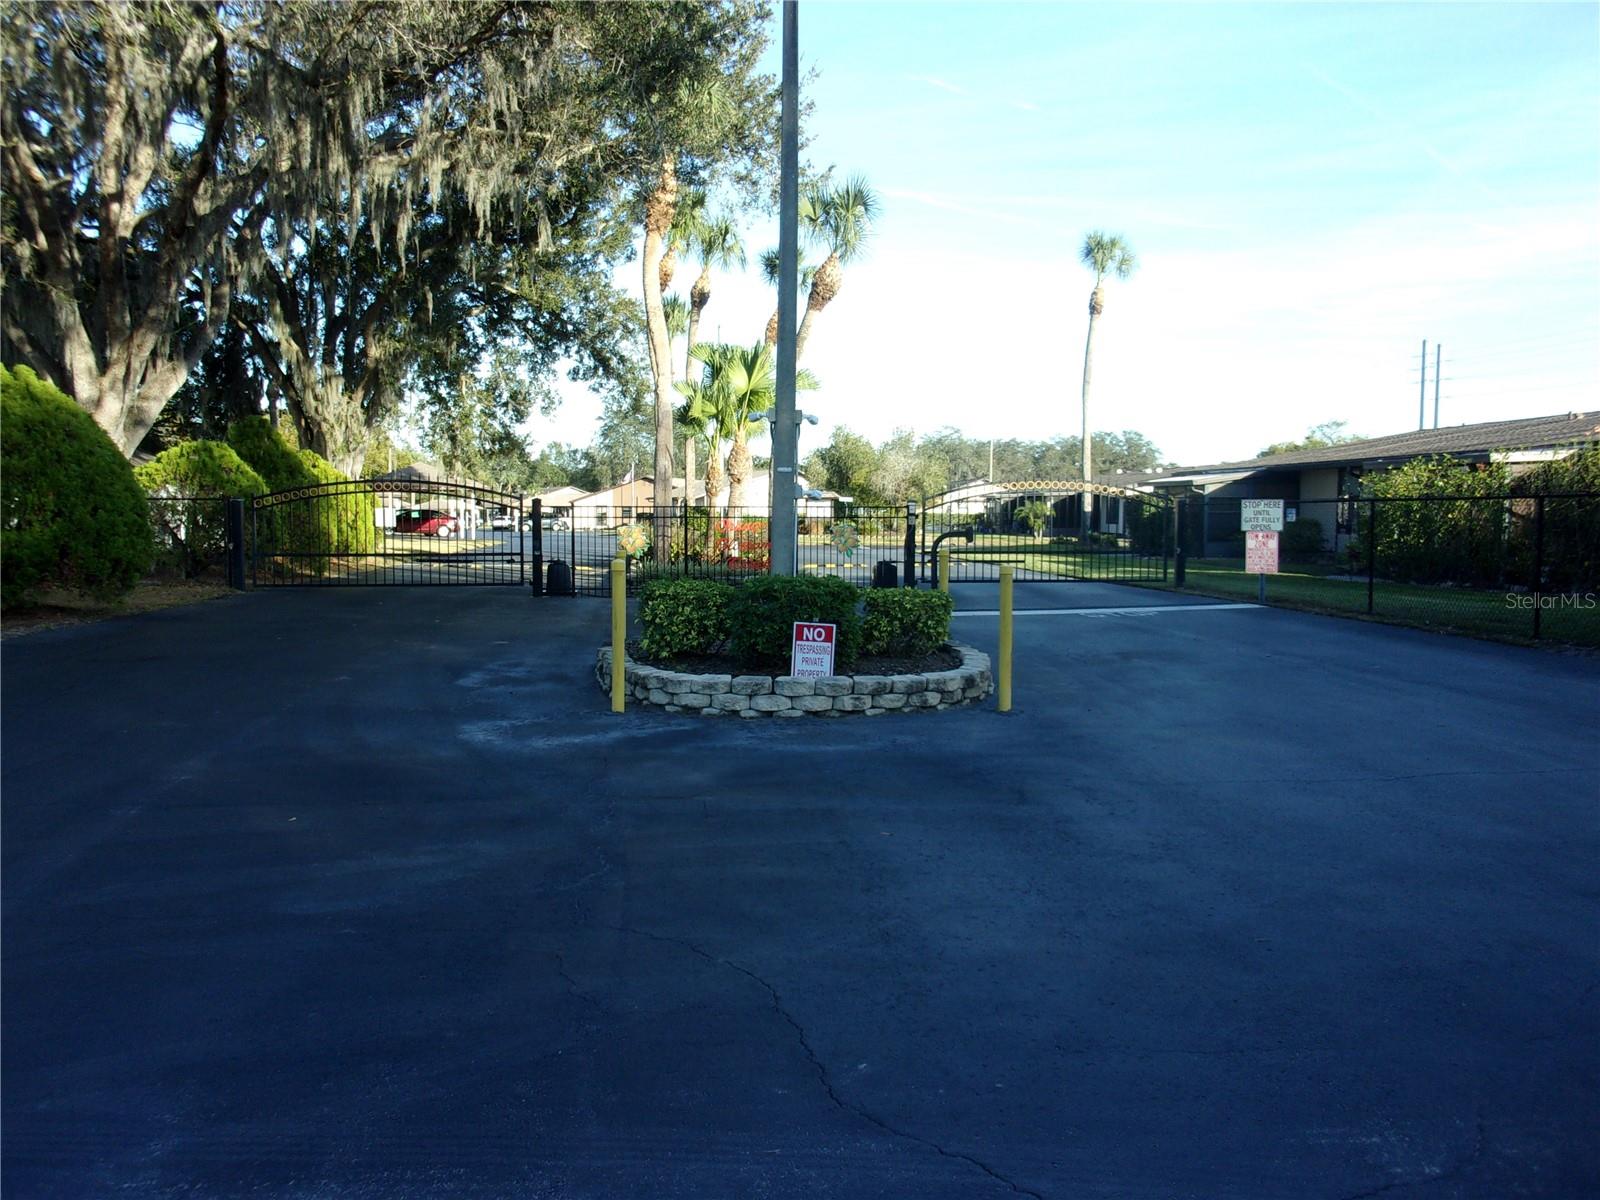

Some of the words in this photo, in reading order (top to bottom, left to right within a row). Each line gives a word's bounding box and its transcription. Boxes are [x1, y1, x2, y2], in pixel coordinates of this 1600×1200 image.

[1243, 500, 1262, 509] STOP
[1263, 500, 1281, 509] HERE
[803, 627, 826, 641] NO
[796, 643, 831, 655] TRESPASSING
[801, 656, 825, 667] PRIVATE
[796, 669, 828, 678] PROPERTY
